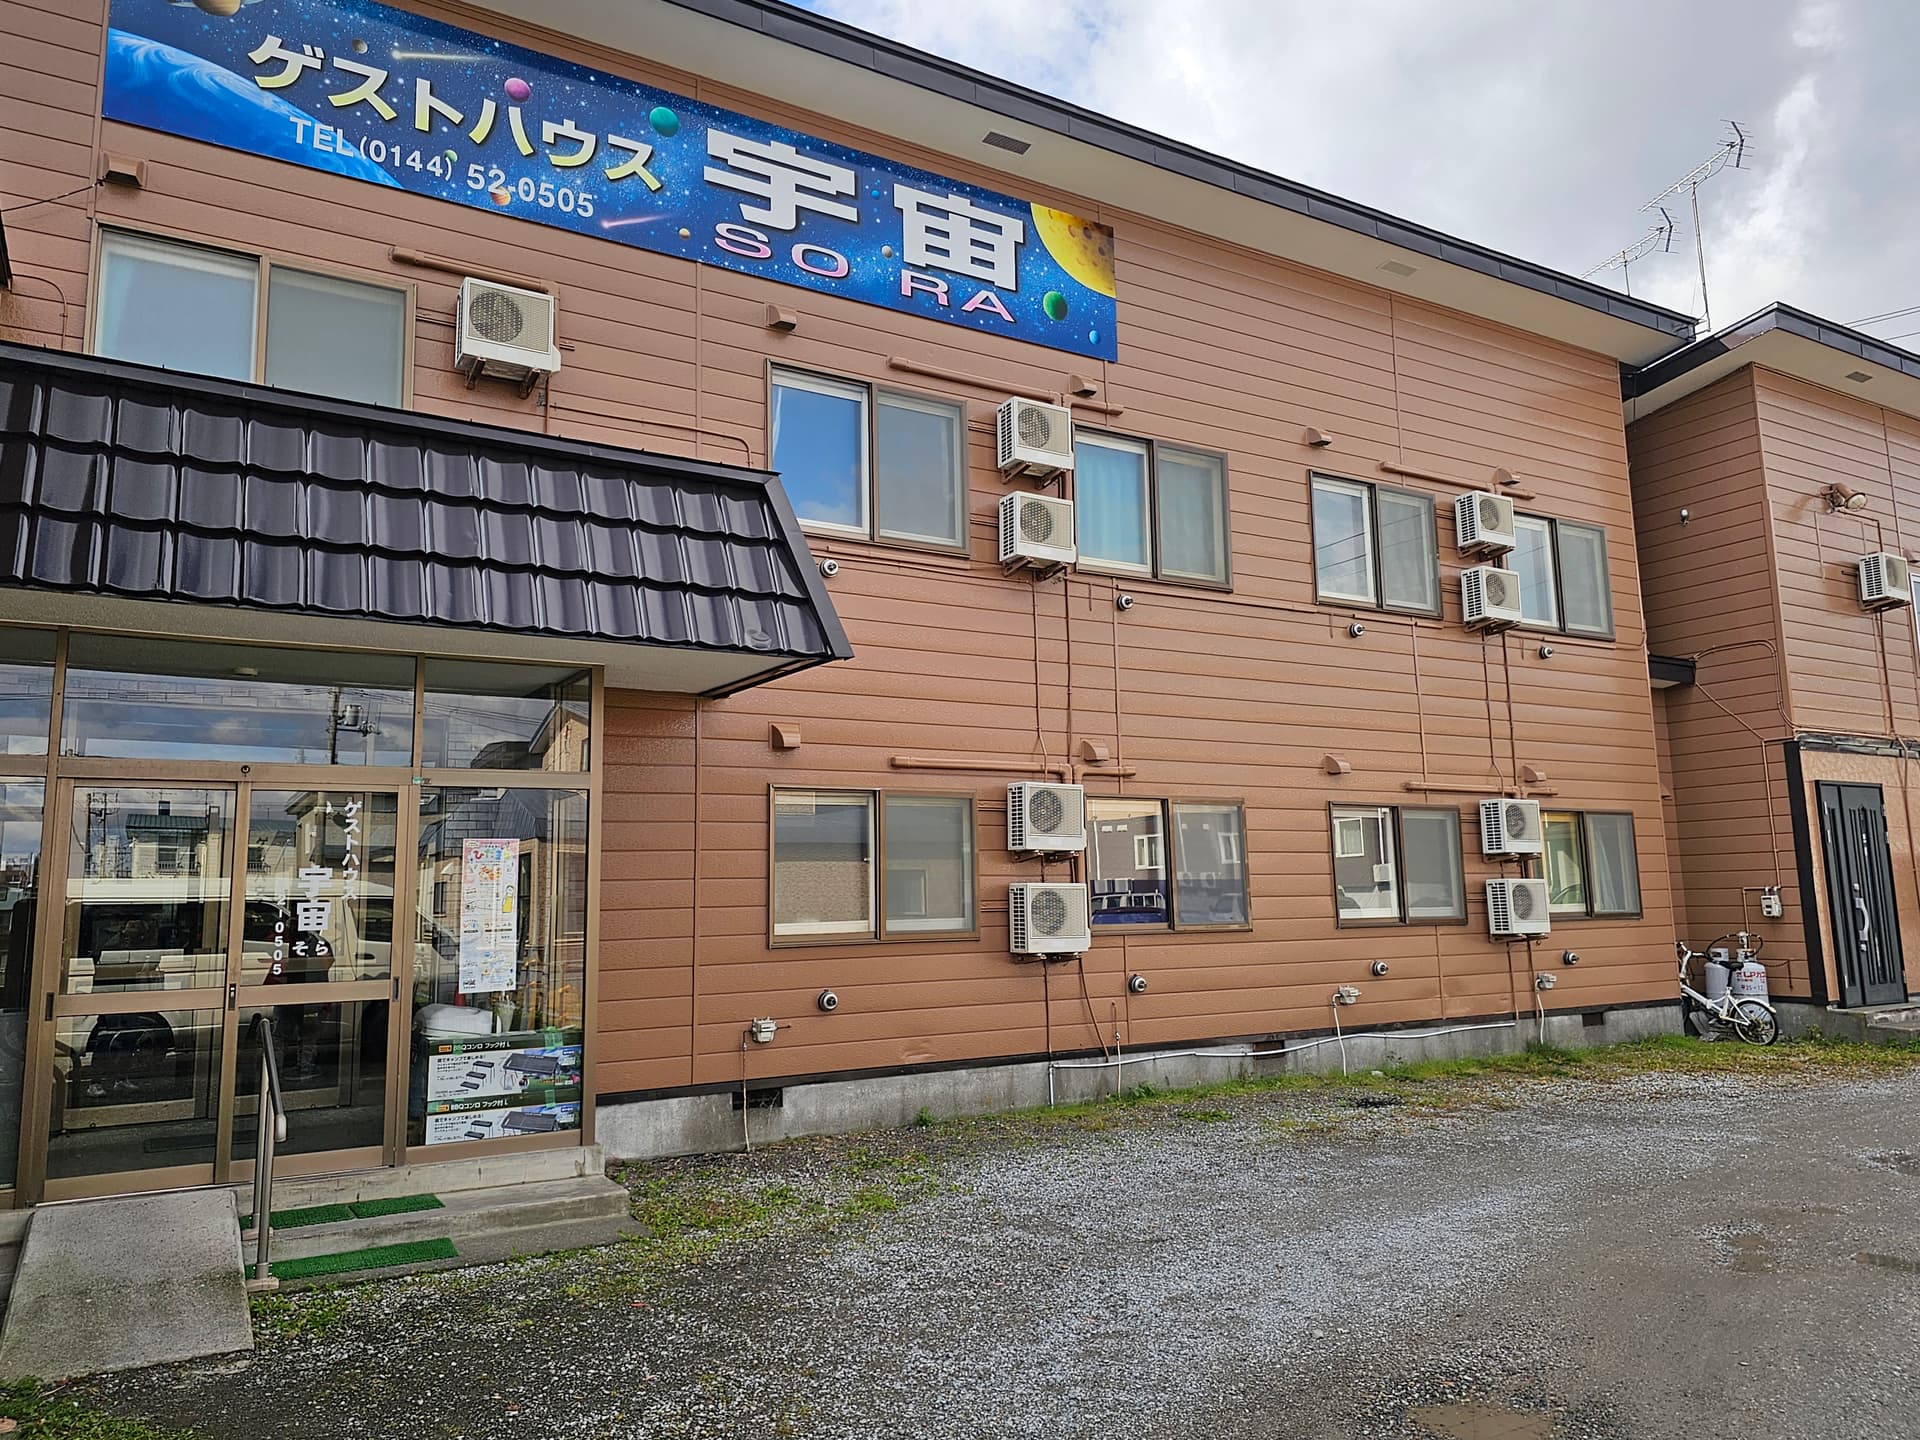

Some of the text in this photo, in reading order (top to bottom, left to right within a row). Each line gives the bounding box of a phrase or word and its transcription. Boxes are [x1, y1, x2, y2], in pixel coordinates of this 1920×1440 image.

[247, 34, 664, 192] ゲストハウス
[703, 127, 1025, 291] 宇宙
[296, 863, 333, 932] 宇宙
[342, 801, 363, 901] ゲストハウス
[292, 941, 329, 957] そら
